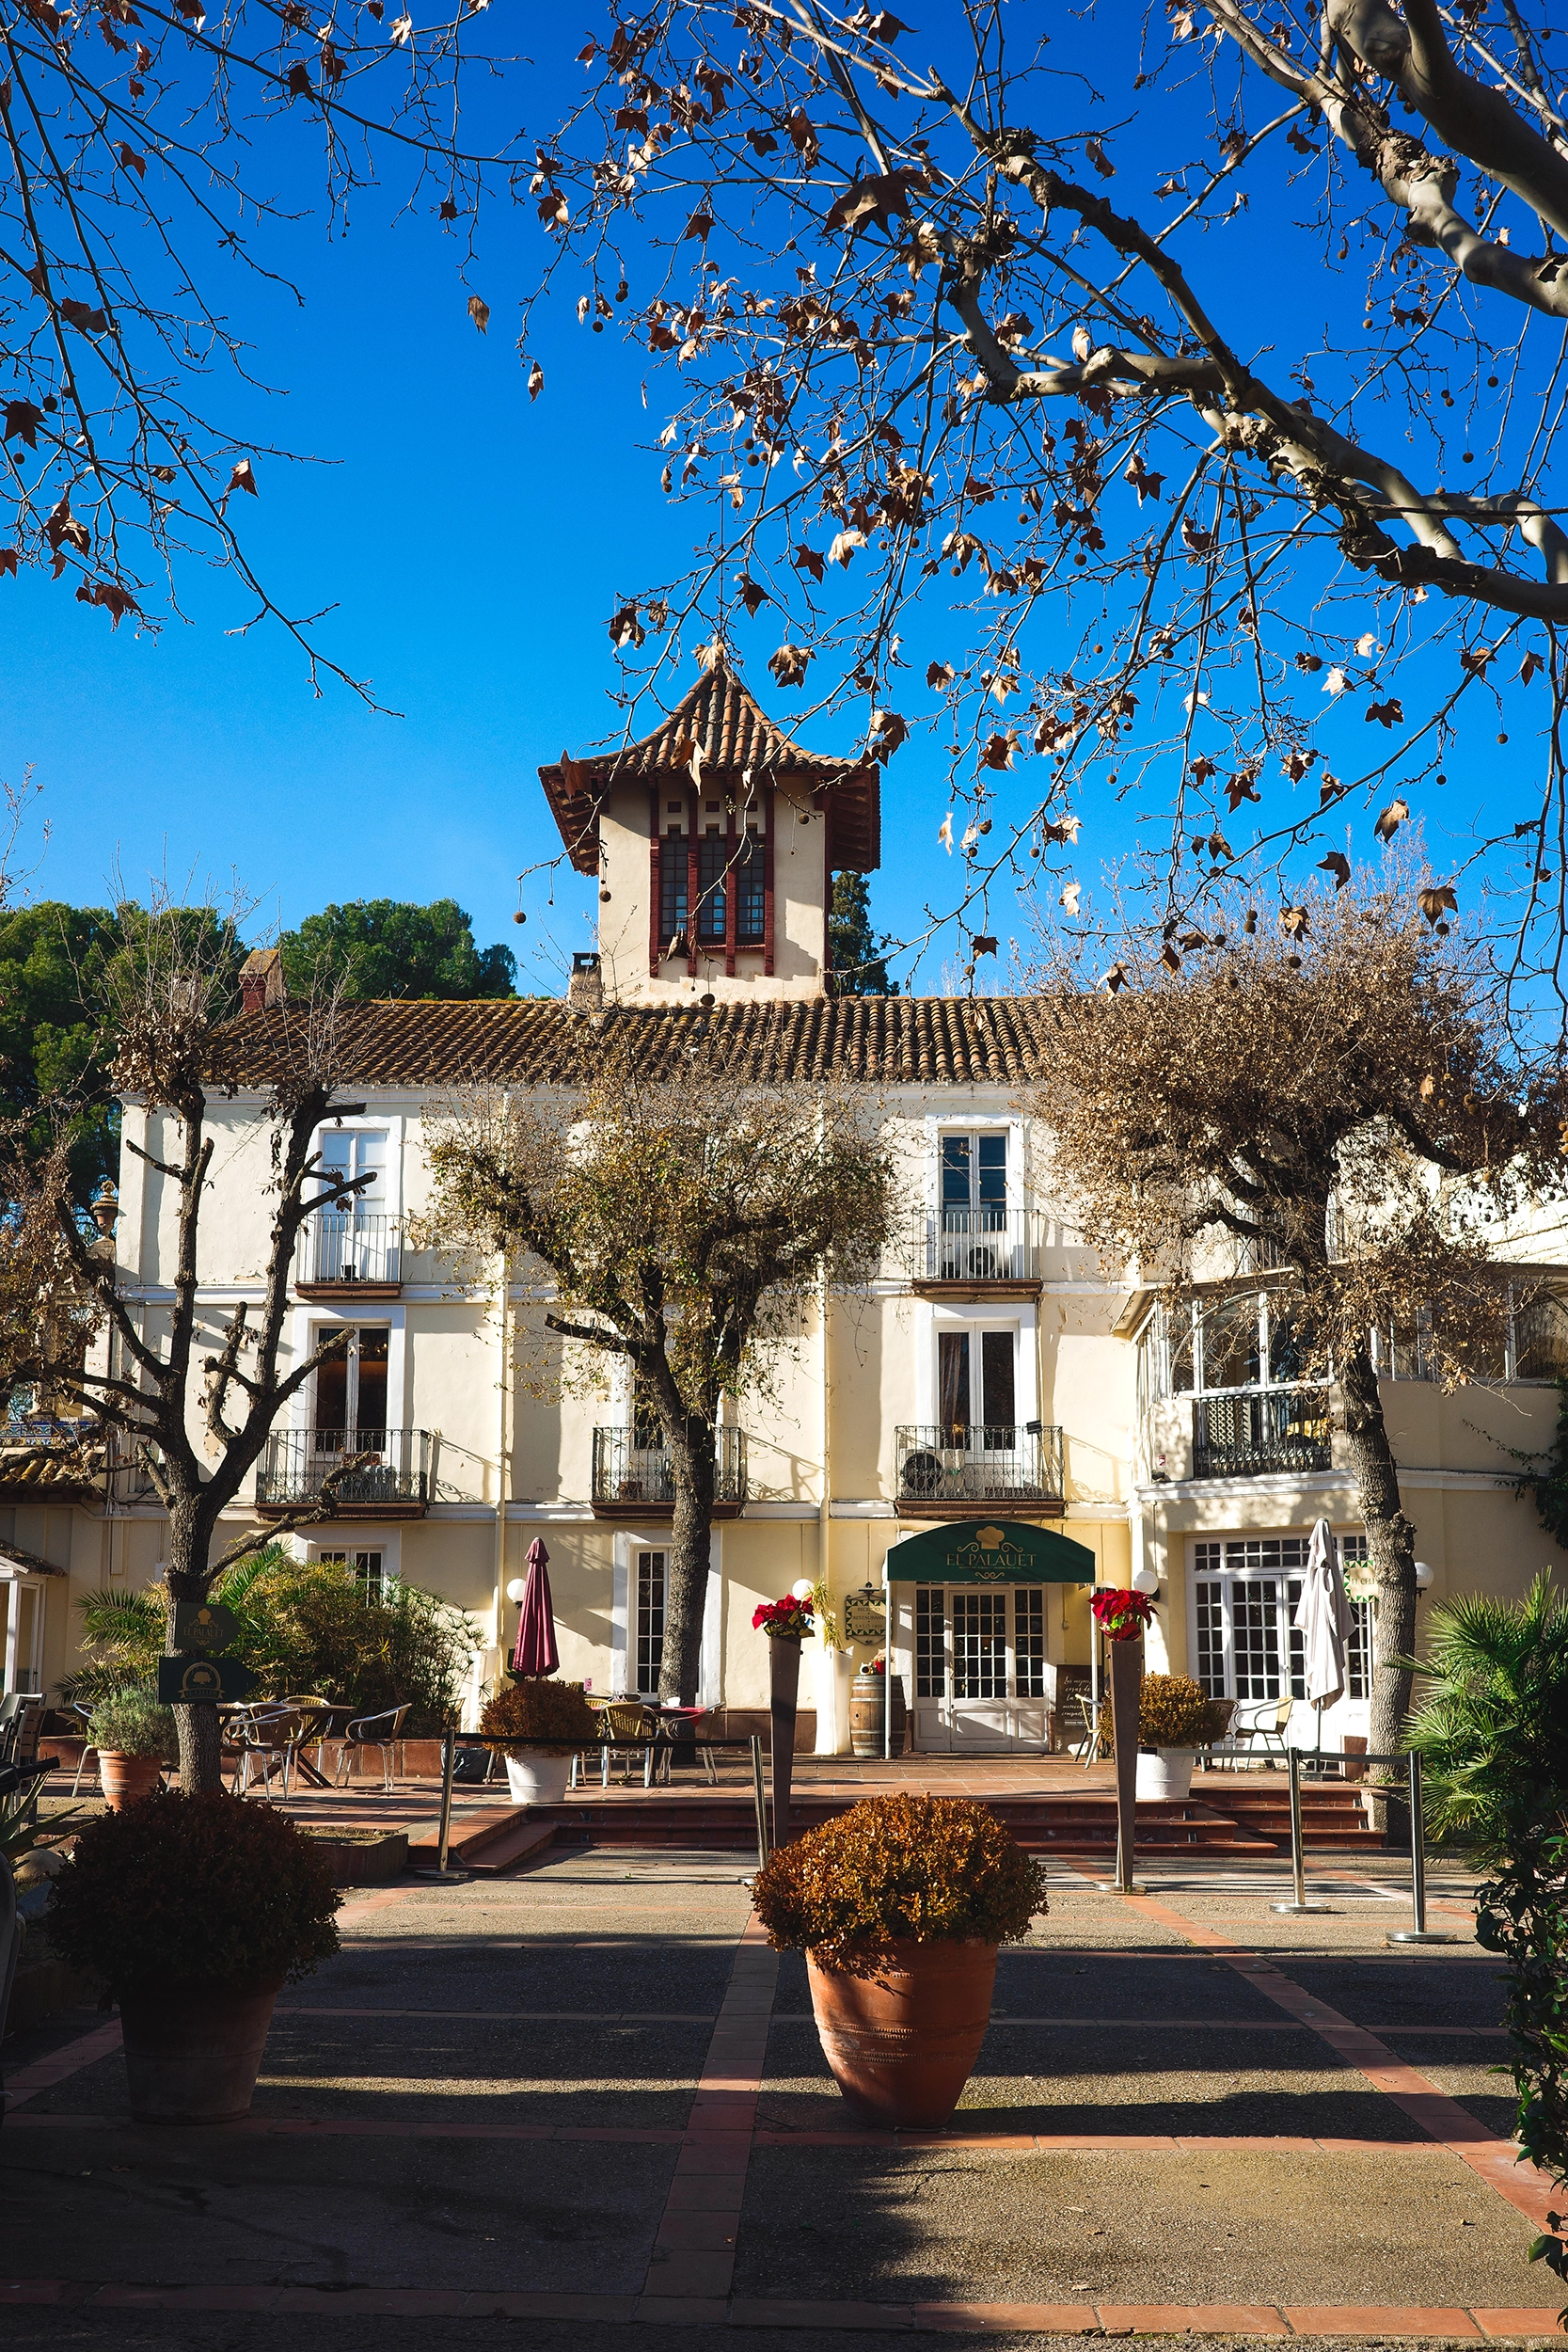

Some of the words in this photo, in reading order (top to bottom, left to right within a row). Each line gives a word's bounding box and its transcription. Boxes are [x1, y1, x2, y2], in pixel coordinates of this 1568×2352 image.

[946, 1554, 964, 1565] EL
[969, 1554, 1037, 1566] PALAUET
[183, 1627, 192, 1635] EL
[194, 1628, 224, 1637] PALAUET
